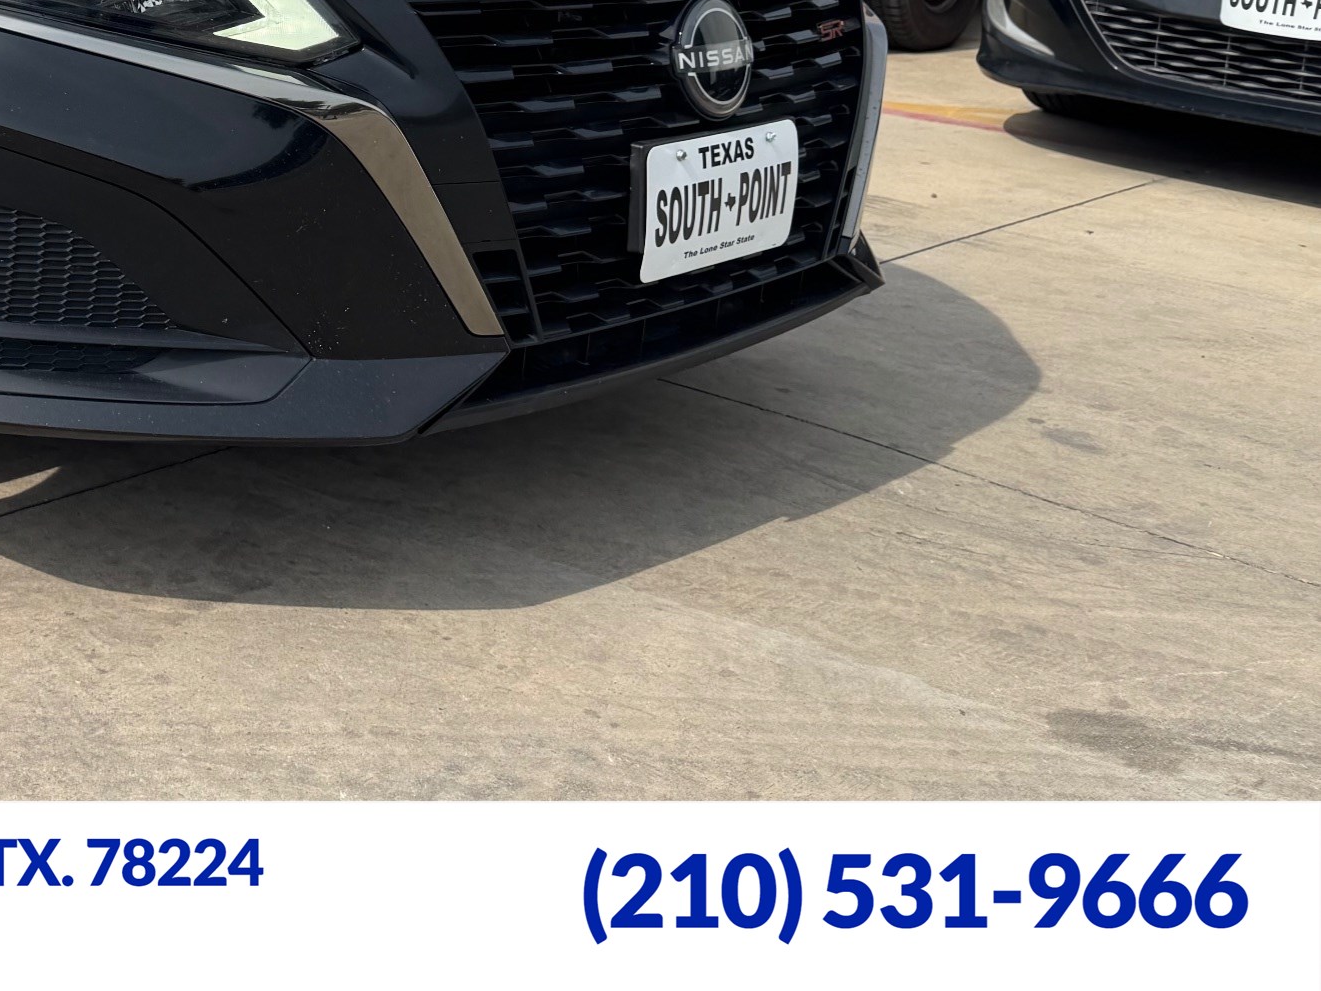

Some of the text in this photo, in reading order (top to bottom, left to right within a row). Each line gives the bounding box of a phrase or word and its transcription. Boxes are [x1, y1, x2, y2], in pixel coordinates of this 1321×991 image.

[819, 19, 845, 41] SR
[678, 44, 754, 70] NISSAN
[698, 137, 755, 169] TEXAS
[655, 161, 792, 248] SOUTH POINT
[683, 234, 755, 259] The Lone Star State
